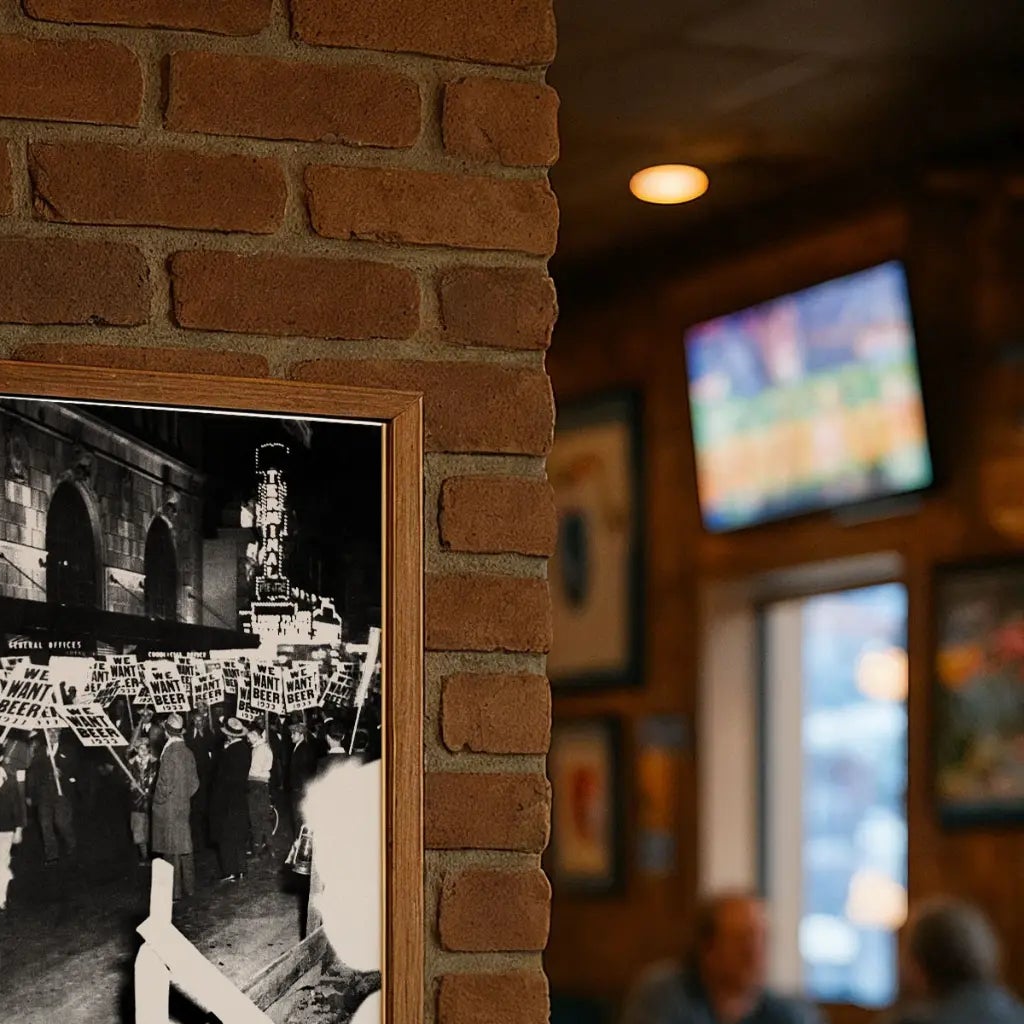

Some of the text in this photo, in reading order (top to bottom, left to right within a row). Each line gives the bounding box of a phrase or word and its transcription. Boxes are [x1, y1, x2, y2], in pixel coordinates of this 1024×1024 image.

[266, 469, 281, 579] TERMINAL
[8, 640, 82, 649] GENERAL OFFICES
[113, 656, 130, 665] WE
[23, 667, 50, 681] WE
[110, 664, 136, 678] WANT
[152, 671, 173, 680] WE
[177, 664, 194, 676] WANT
[257, 664, 275, 676] WE
[289, 668, 307, 679] WE
[91, 671, 109, 682] ANT
[199, 674, 215, 683] WE
[253, 672, 280, 691] WANT
[150, 680, 181, 694] WANT
[195, 679, 220, 693] WANT
[286, 675, 313, 693] WANT
[6, 680, 54, 702] WANT
[253, 687, 280, 704] BEER
[287, 689, 315, 704] BEER
[154, 693, 186, 705] BEER
[66, 707, 94, 716] WE
[66, 715, 109, 728] WANT
[77, 727, 120, 739] BEER
